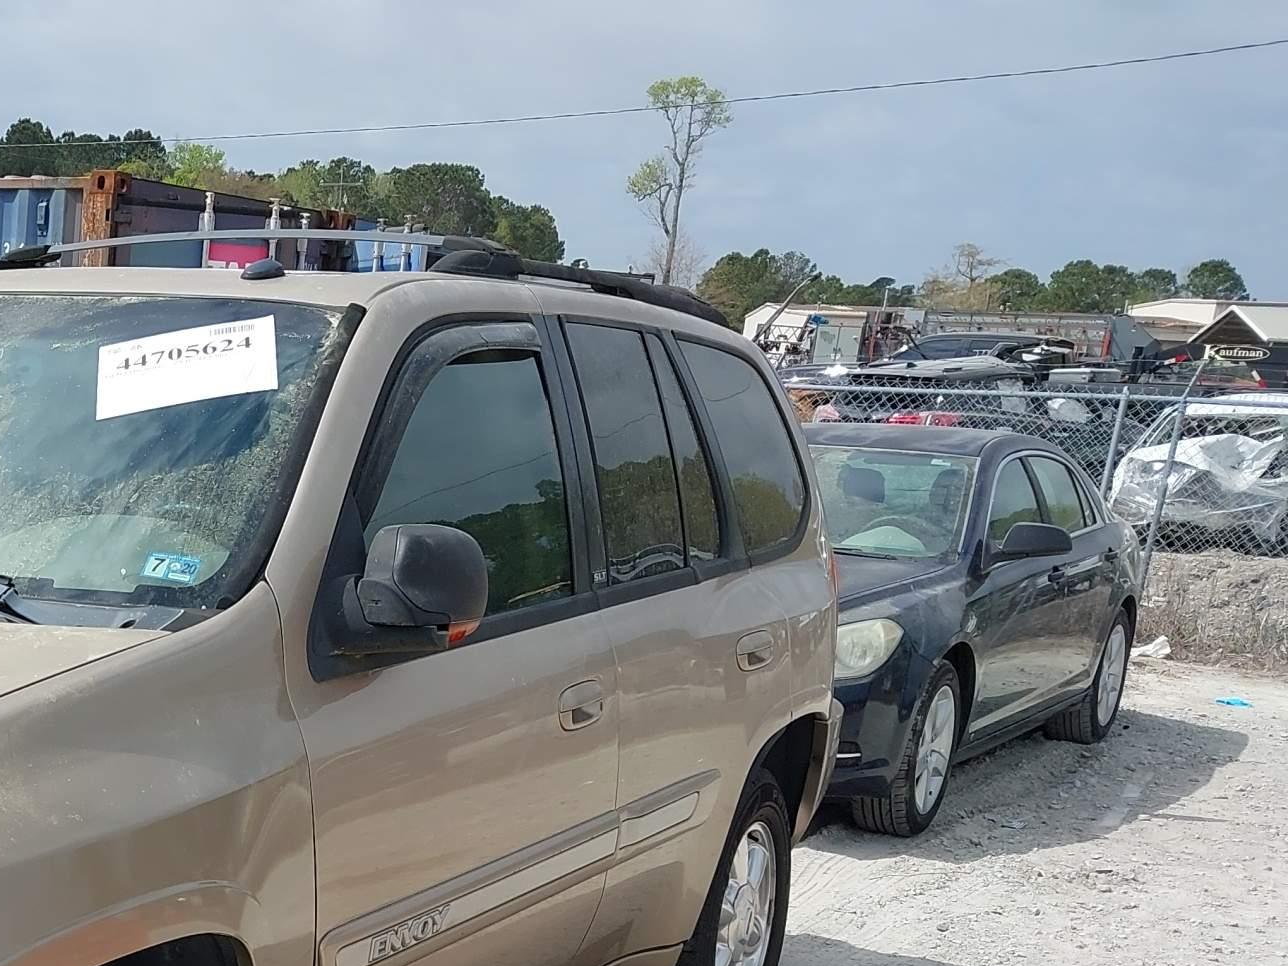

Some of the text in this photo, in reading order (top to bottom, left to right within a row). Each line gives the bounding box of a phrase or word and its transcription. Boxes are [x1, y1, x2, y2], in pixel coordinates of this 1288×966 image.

[116, 336, 252, 370] 44705624
[1203, 344, 1264, 361] Kaufman
[151, 557, 166, 572] 7
[368, 904, 451, 963] ENVOY
